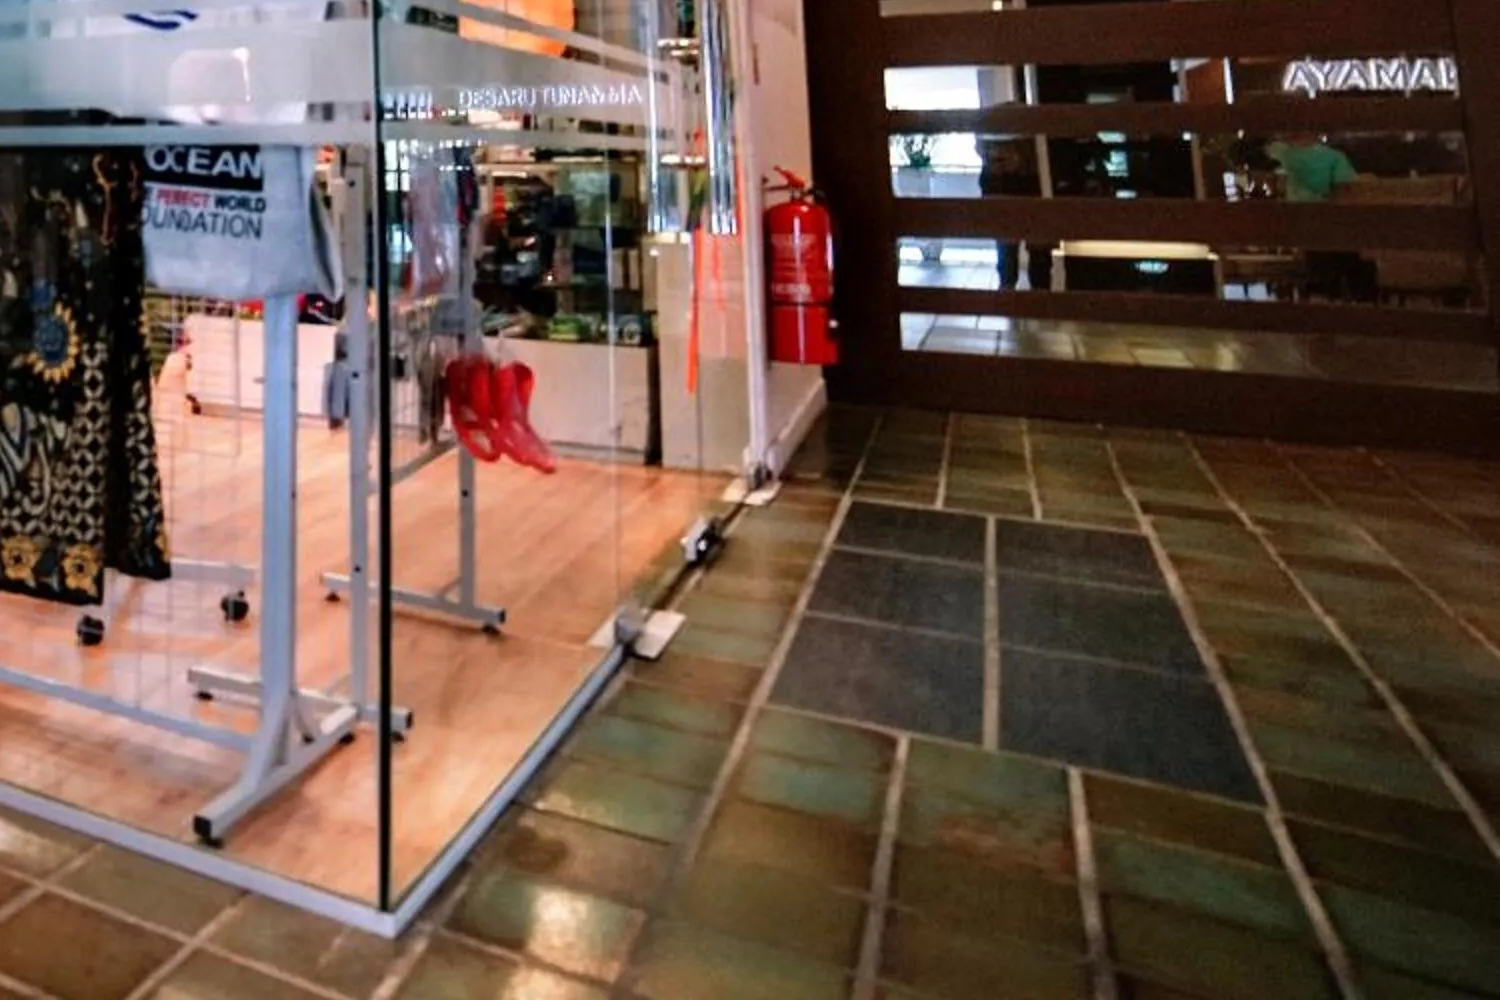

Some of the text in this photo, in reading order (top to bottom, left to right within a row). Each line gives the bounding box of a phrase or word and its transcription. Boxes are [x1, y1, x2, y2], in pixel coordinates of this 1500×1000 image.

[147, 145, 262, 180] OCEAN
[214, 194, 267, 213] WORLD
[141, 205, 263, 240] OUNDATION
